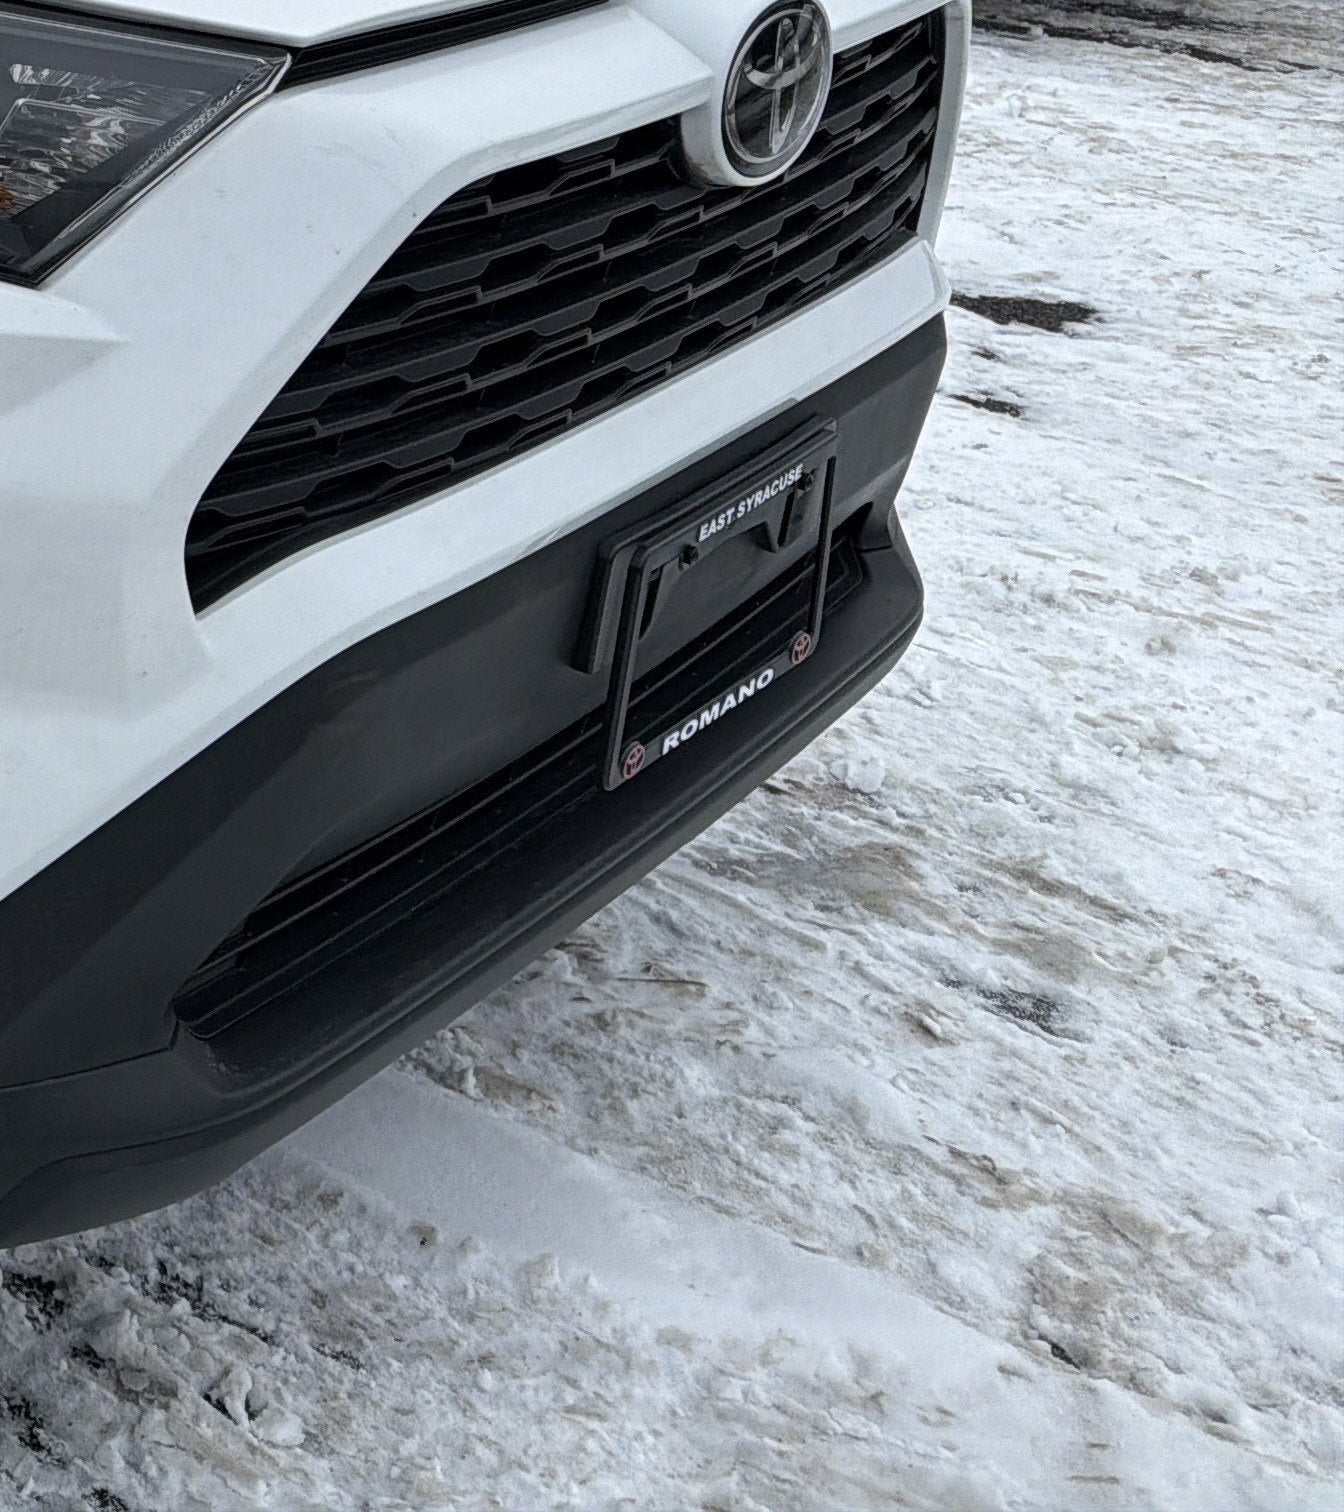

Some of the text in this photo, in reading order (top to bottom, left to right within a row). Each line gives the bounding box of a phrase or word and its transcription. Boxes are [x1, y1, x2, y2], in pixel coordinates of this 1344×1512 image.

[697, 462, 804, 543] EAST SYRACUSE
[661, 667, 775, 756] ROMANO
